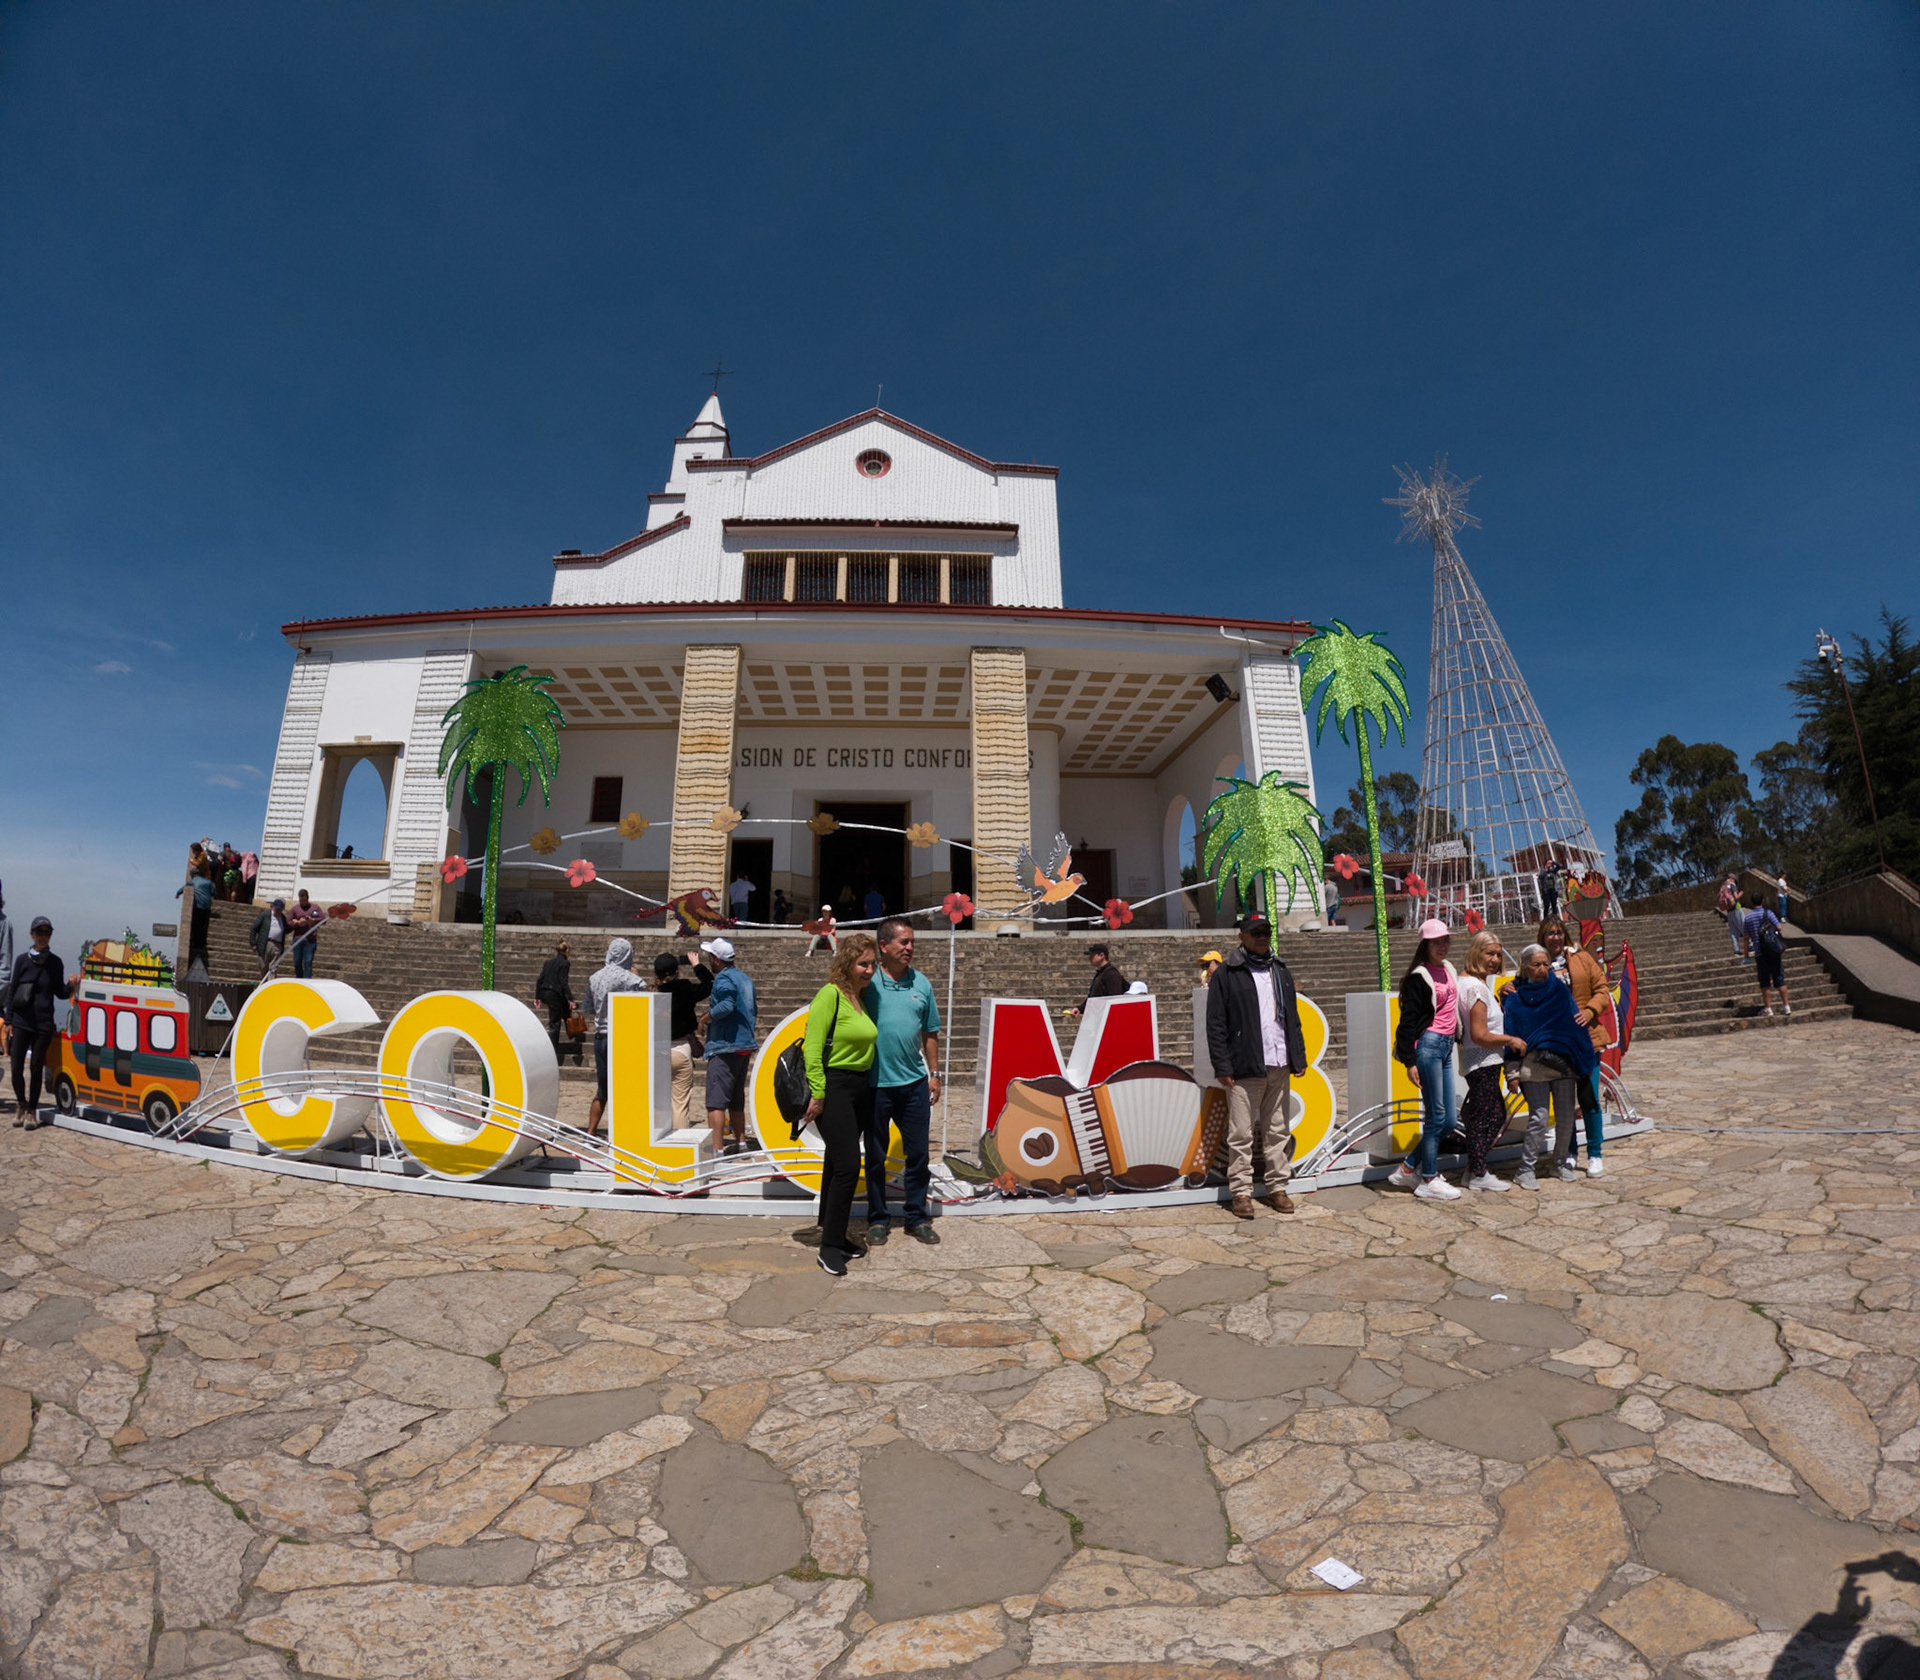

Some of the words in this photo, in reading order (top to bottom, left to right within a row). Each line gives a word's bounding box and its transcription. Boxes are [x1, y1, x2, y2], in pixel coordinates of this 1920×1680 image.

[735, 748, 783, 767] SION
[794, 748, 816, 767] DE
[827, 748, 894, 768] CRISTO
